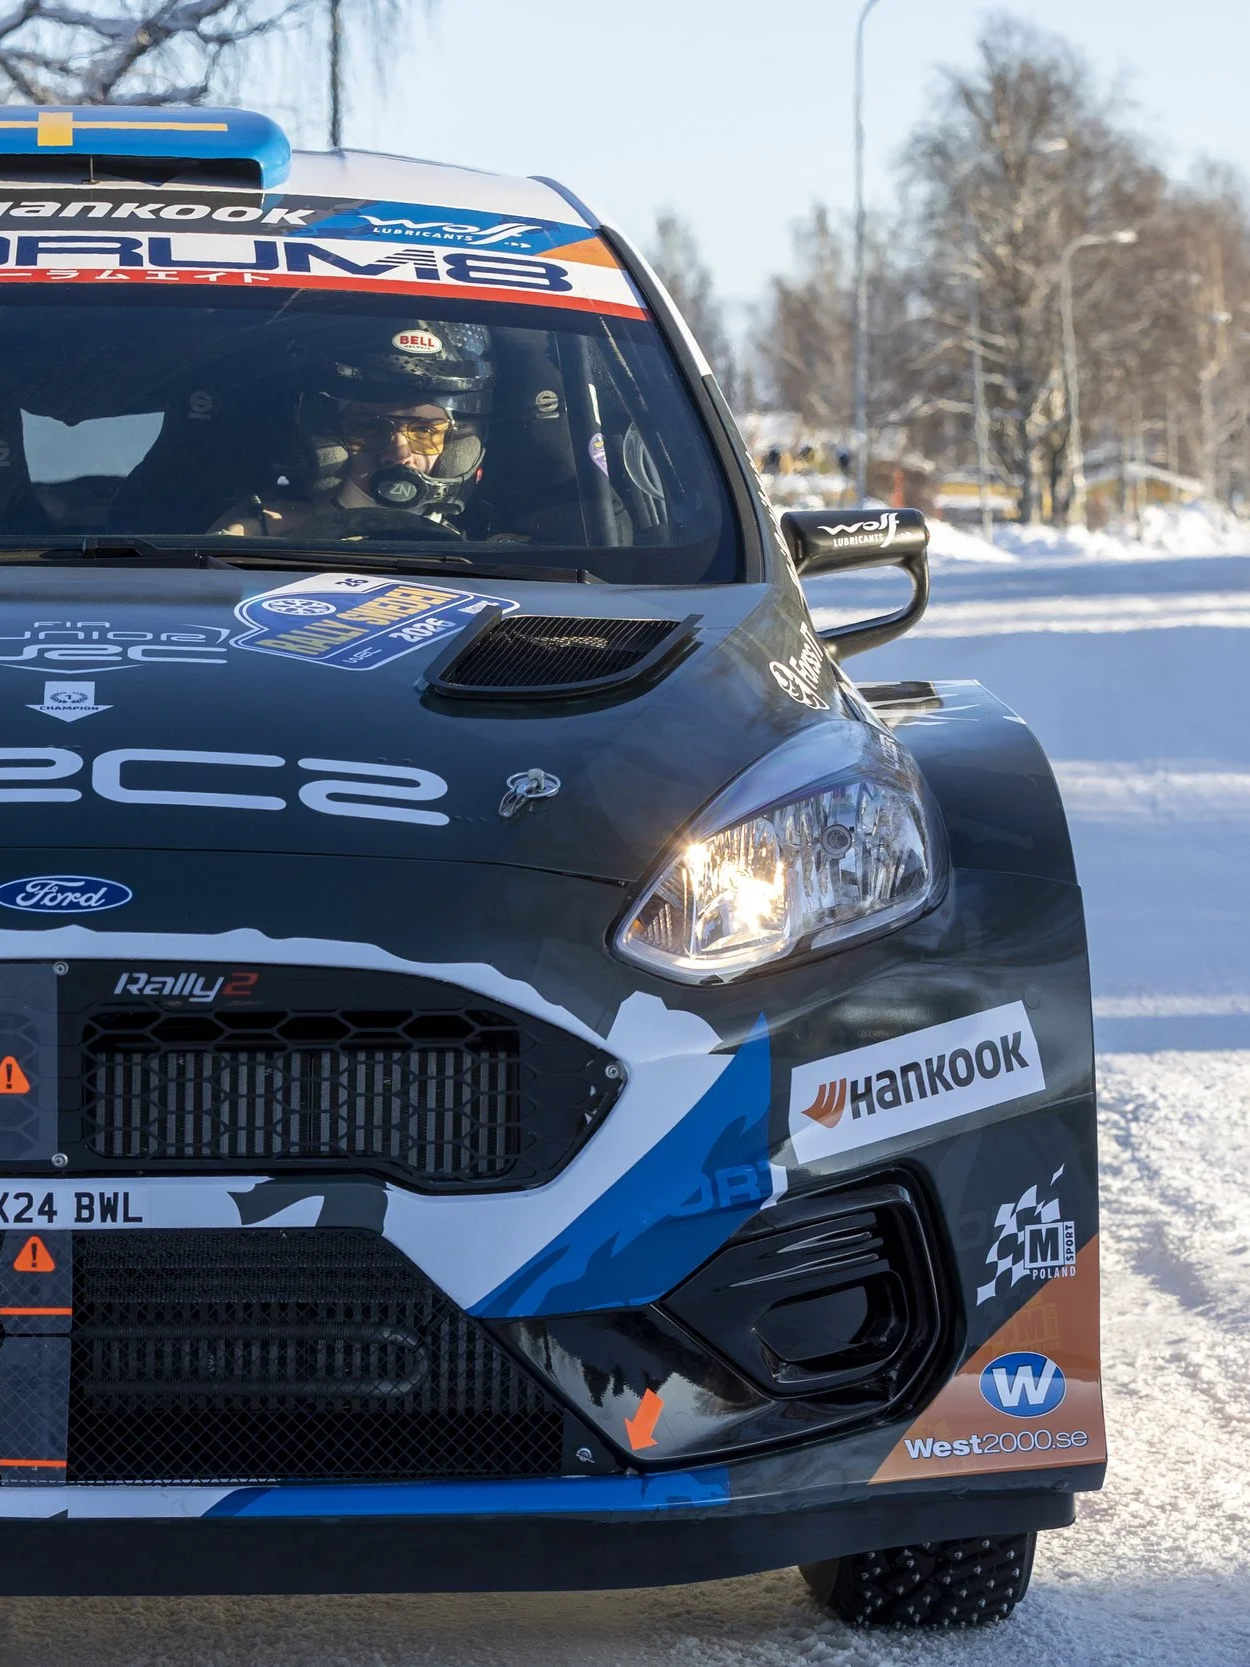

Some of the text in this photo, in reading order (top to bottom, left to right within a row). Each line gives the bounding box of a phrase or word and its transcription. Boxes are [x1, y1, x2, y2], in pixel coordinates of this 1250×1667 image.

[372, 227, 473, 242] LUBRICANTS
[399, 335, 435, 348] BELL
[833, 533, 885, 548] LUBRICANTS
[254, 585, 461, 655] RALLY SWEDEN
[15, 880, 108, 907] Ford
[74, 1192, 144, 1224] BWL
[1029, 1226, 1060, 1264] M
[1065, 1224, 1075, 1262] SPORT
[1032, 1265, 1076, 1281] POLAND
[992, 1358, 1060, 1408] W
[904, 1429, 1088, 1460] West2000.se
